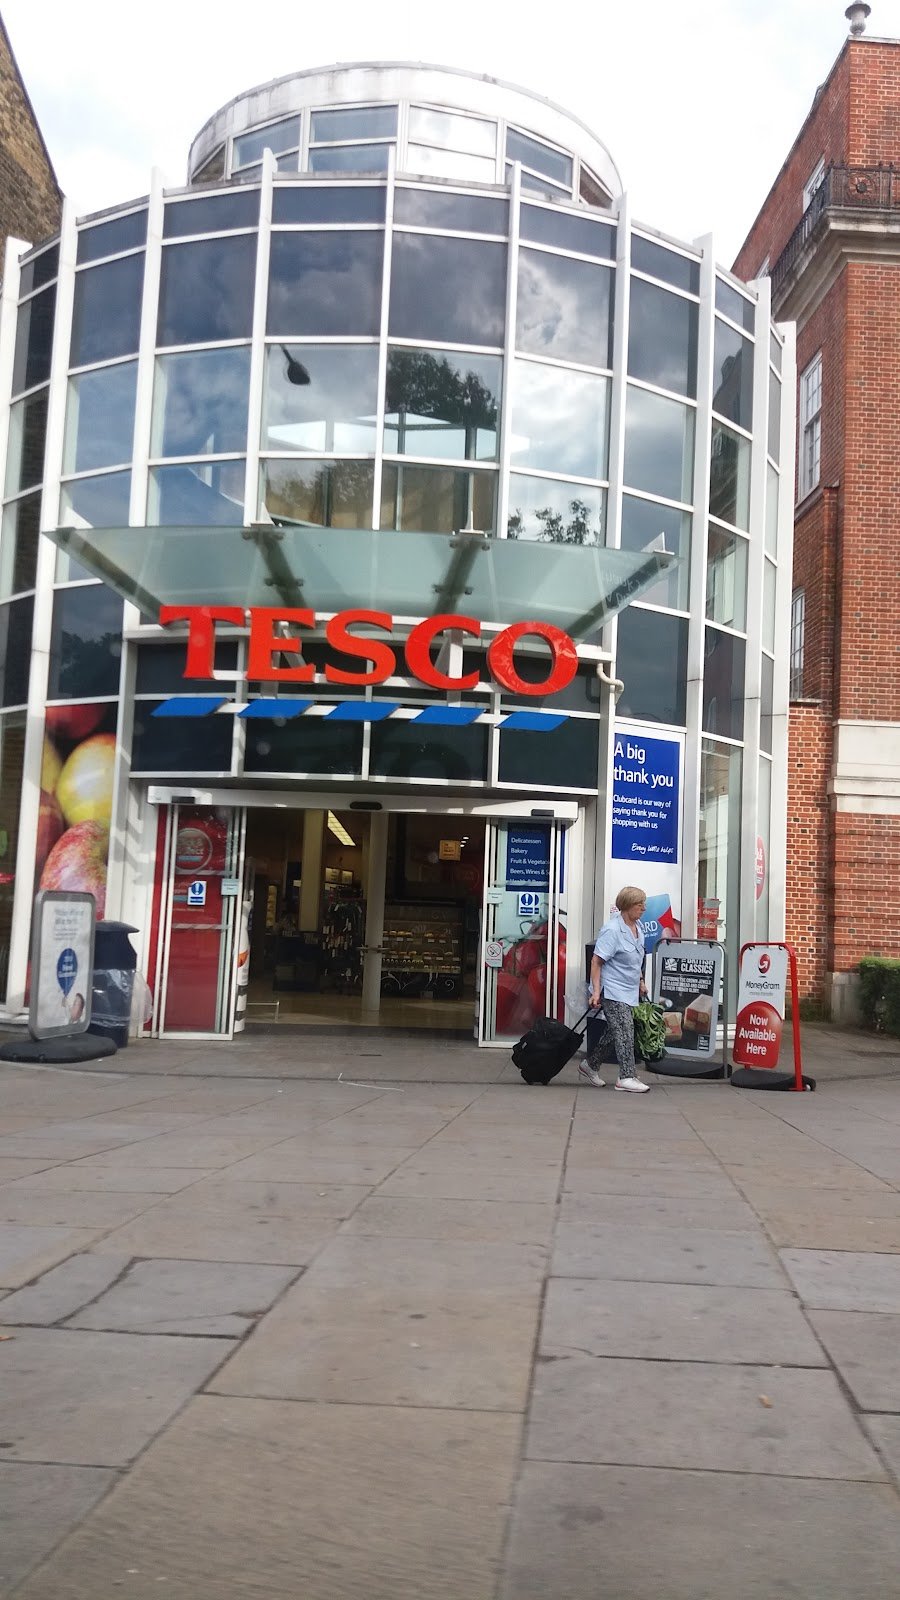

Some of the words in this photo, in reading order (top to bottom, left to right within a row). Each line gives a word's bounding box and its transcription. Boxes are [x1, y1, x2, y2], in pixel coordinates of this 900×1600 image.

[159, 605, 579, 696] TESCO
[614, 742, 624, 758] A
[627, 743, 646, 764] big
[614, 765, 649, 784] thank
[651, 773, 674, 788] you
[613, 795, 638, 804] Clubcard
[613, 807, 631, 817] saying
[631, 808, 648, 816] thank
[659, 811, 668, 819] for
[612, 817, 638, 828] shopping
[511, 847, 528, 855] Bakery
[632, 843, 646, 854] Every
[681, 963, 713, 974] CLASSICS
[745, 981, 780, 991] MoneyGram
[749, 1014, 768, 1026] Now
[739, 1027, 776, 1042] Available
[746, 1042, 767, 1056] Here
